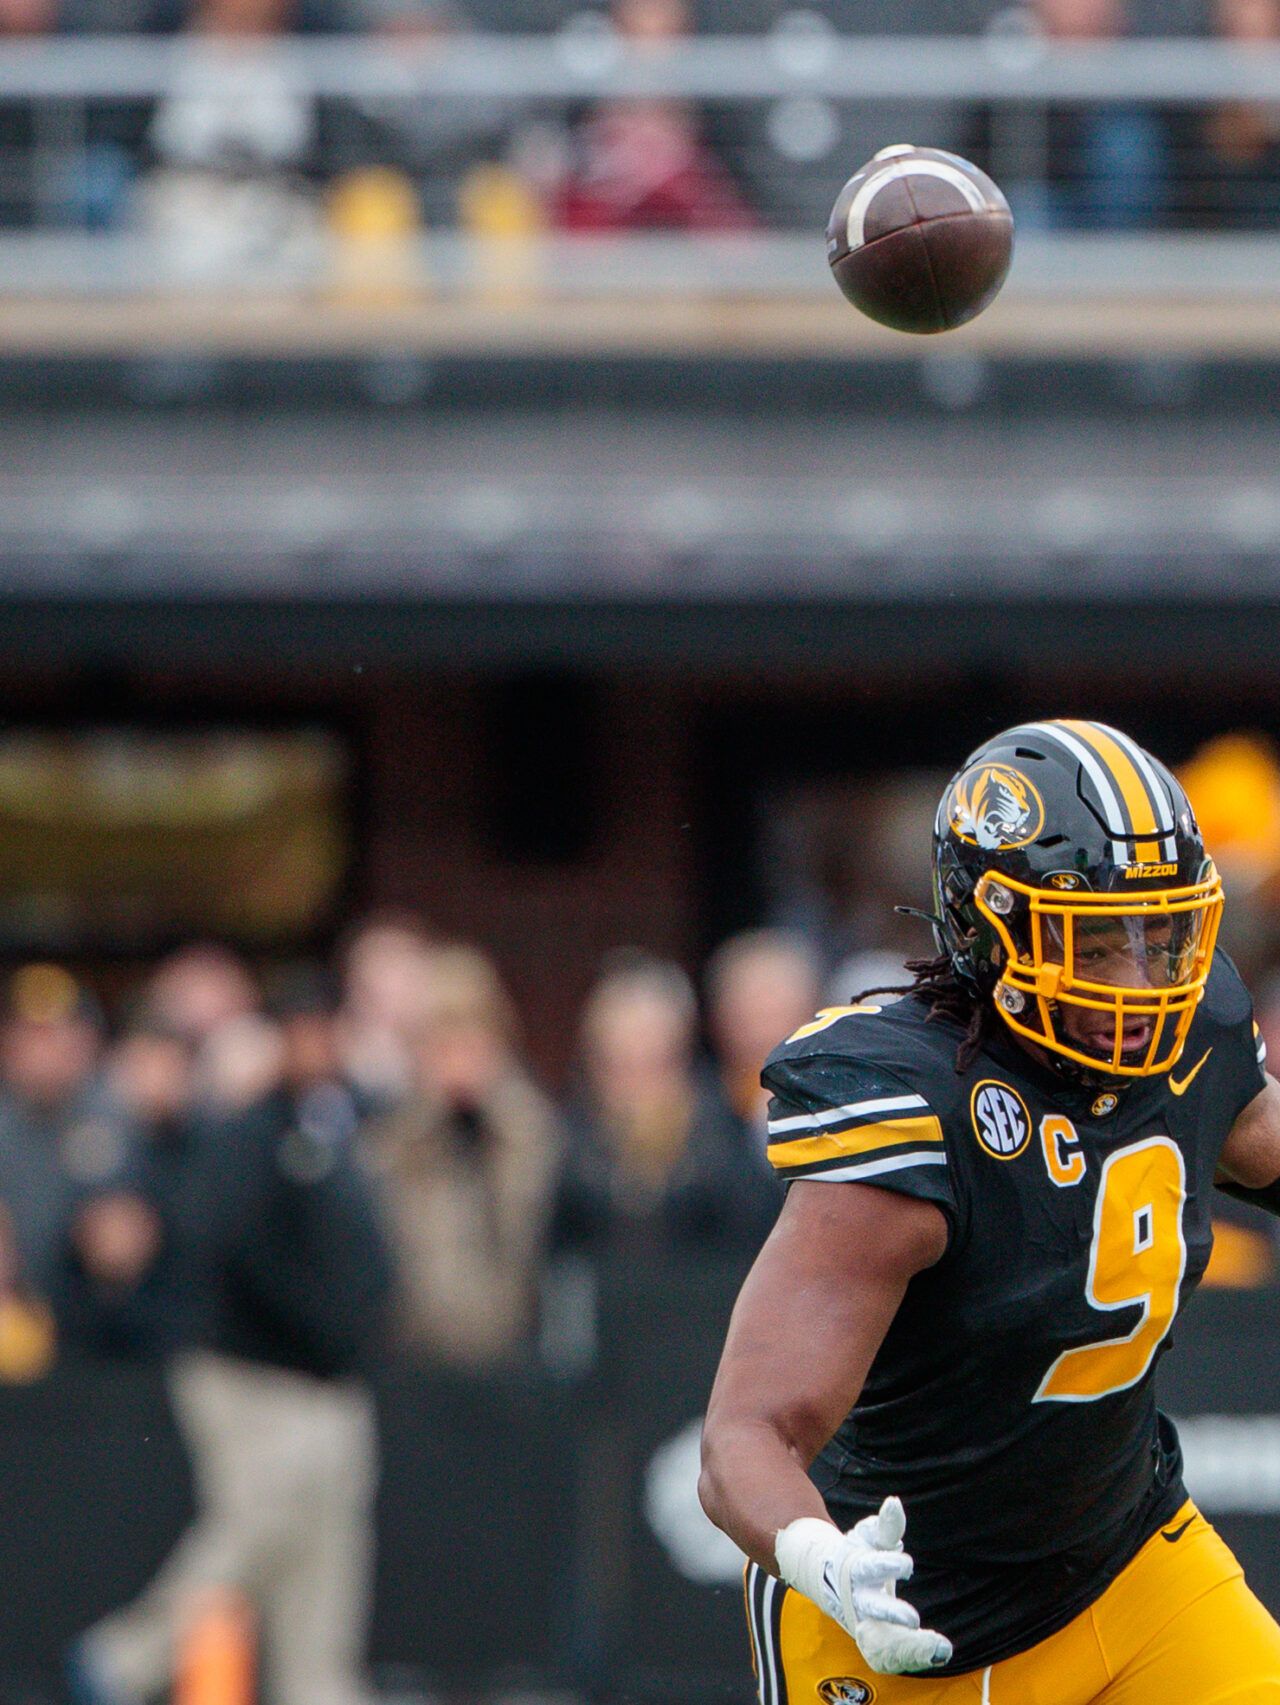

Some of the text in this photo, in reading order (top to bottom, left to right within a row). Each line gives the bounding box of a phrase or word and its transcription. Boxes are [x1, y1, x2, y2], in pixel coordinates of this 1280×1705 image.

[1125, 863, 1178, 879] MIZZOU
[977, 1087, 1026, 1153] SEC
[1039, 1114, 1087, 1188] C
[1031, 1136, 1187, 1404] 9
